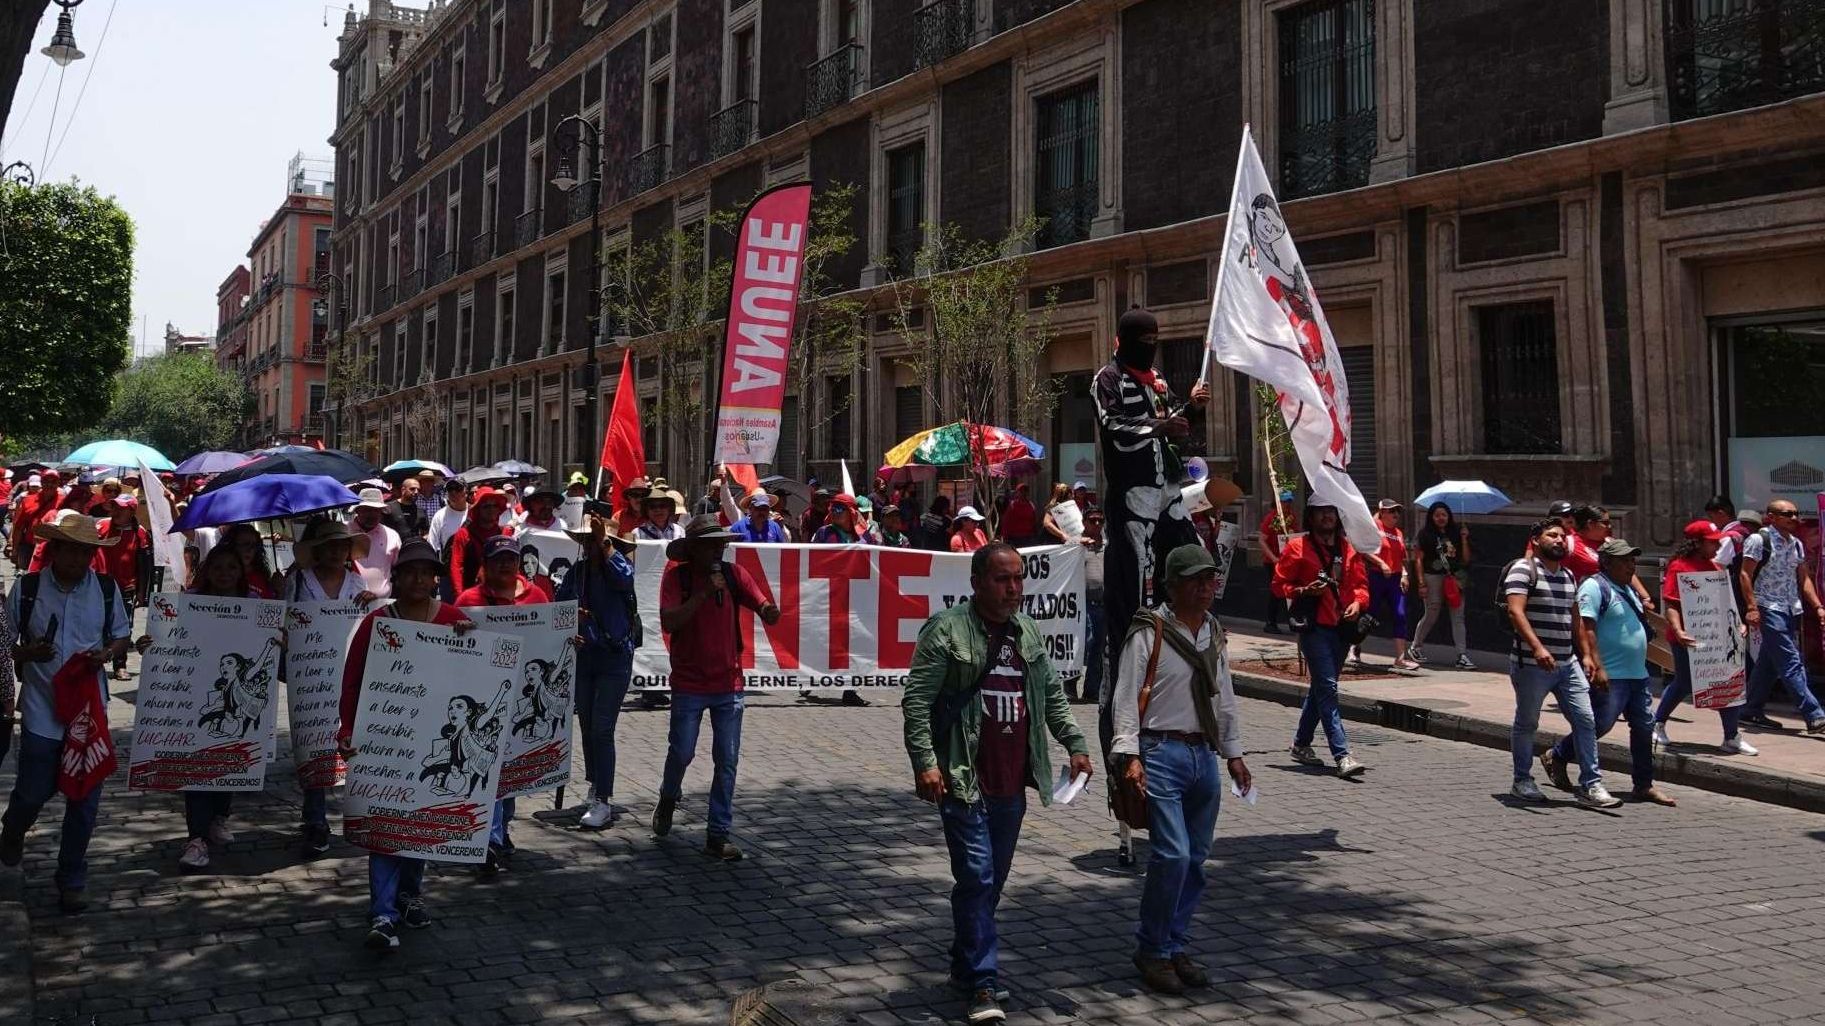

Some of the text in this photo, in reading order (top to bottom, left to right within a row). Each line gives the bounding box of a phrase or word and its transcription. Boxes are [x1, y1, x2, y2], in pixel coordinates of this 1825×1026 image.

[188, 602, 242, 614] Sección 9
[735, 548, 933, 670] NTE
[486, 611, 538, 623] Sección 9
[168, 627, 189, 640] Me
[305, 631, 323, 644] Me
[416, 631, 477, 649] Sección 9
[149, 643, 201, 659] enseñaste
[162, 662, 182, 675] leer
[187, 666, 195, 676] y
[390, 660, 415, 675] Me
[632, 675, 668, 687] QUI
[810, 675, 845, 687] LOS
[851, 675, 911, 687] DEREC
[368, 680, 428, 698] enseñaste
[144, 697, 194, 709] ahora me
[369, 700, 419, 718] a leer y
[140, 714, 183, 727] enseñas
[360, 741, 416, 760] ahora me
[353, 763, 401, 780] enseñas
[406, 772, 415, 781] a
